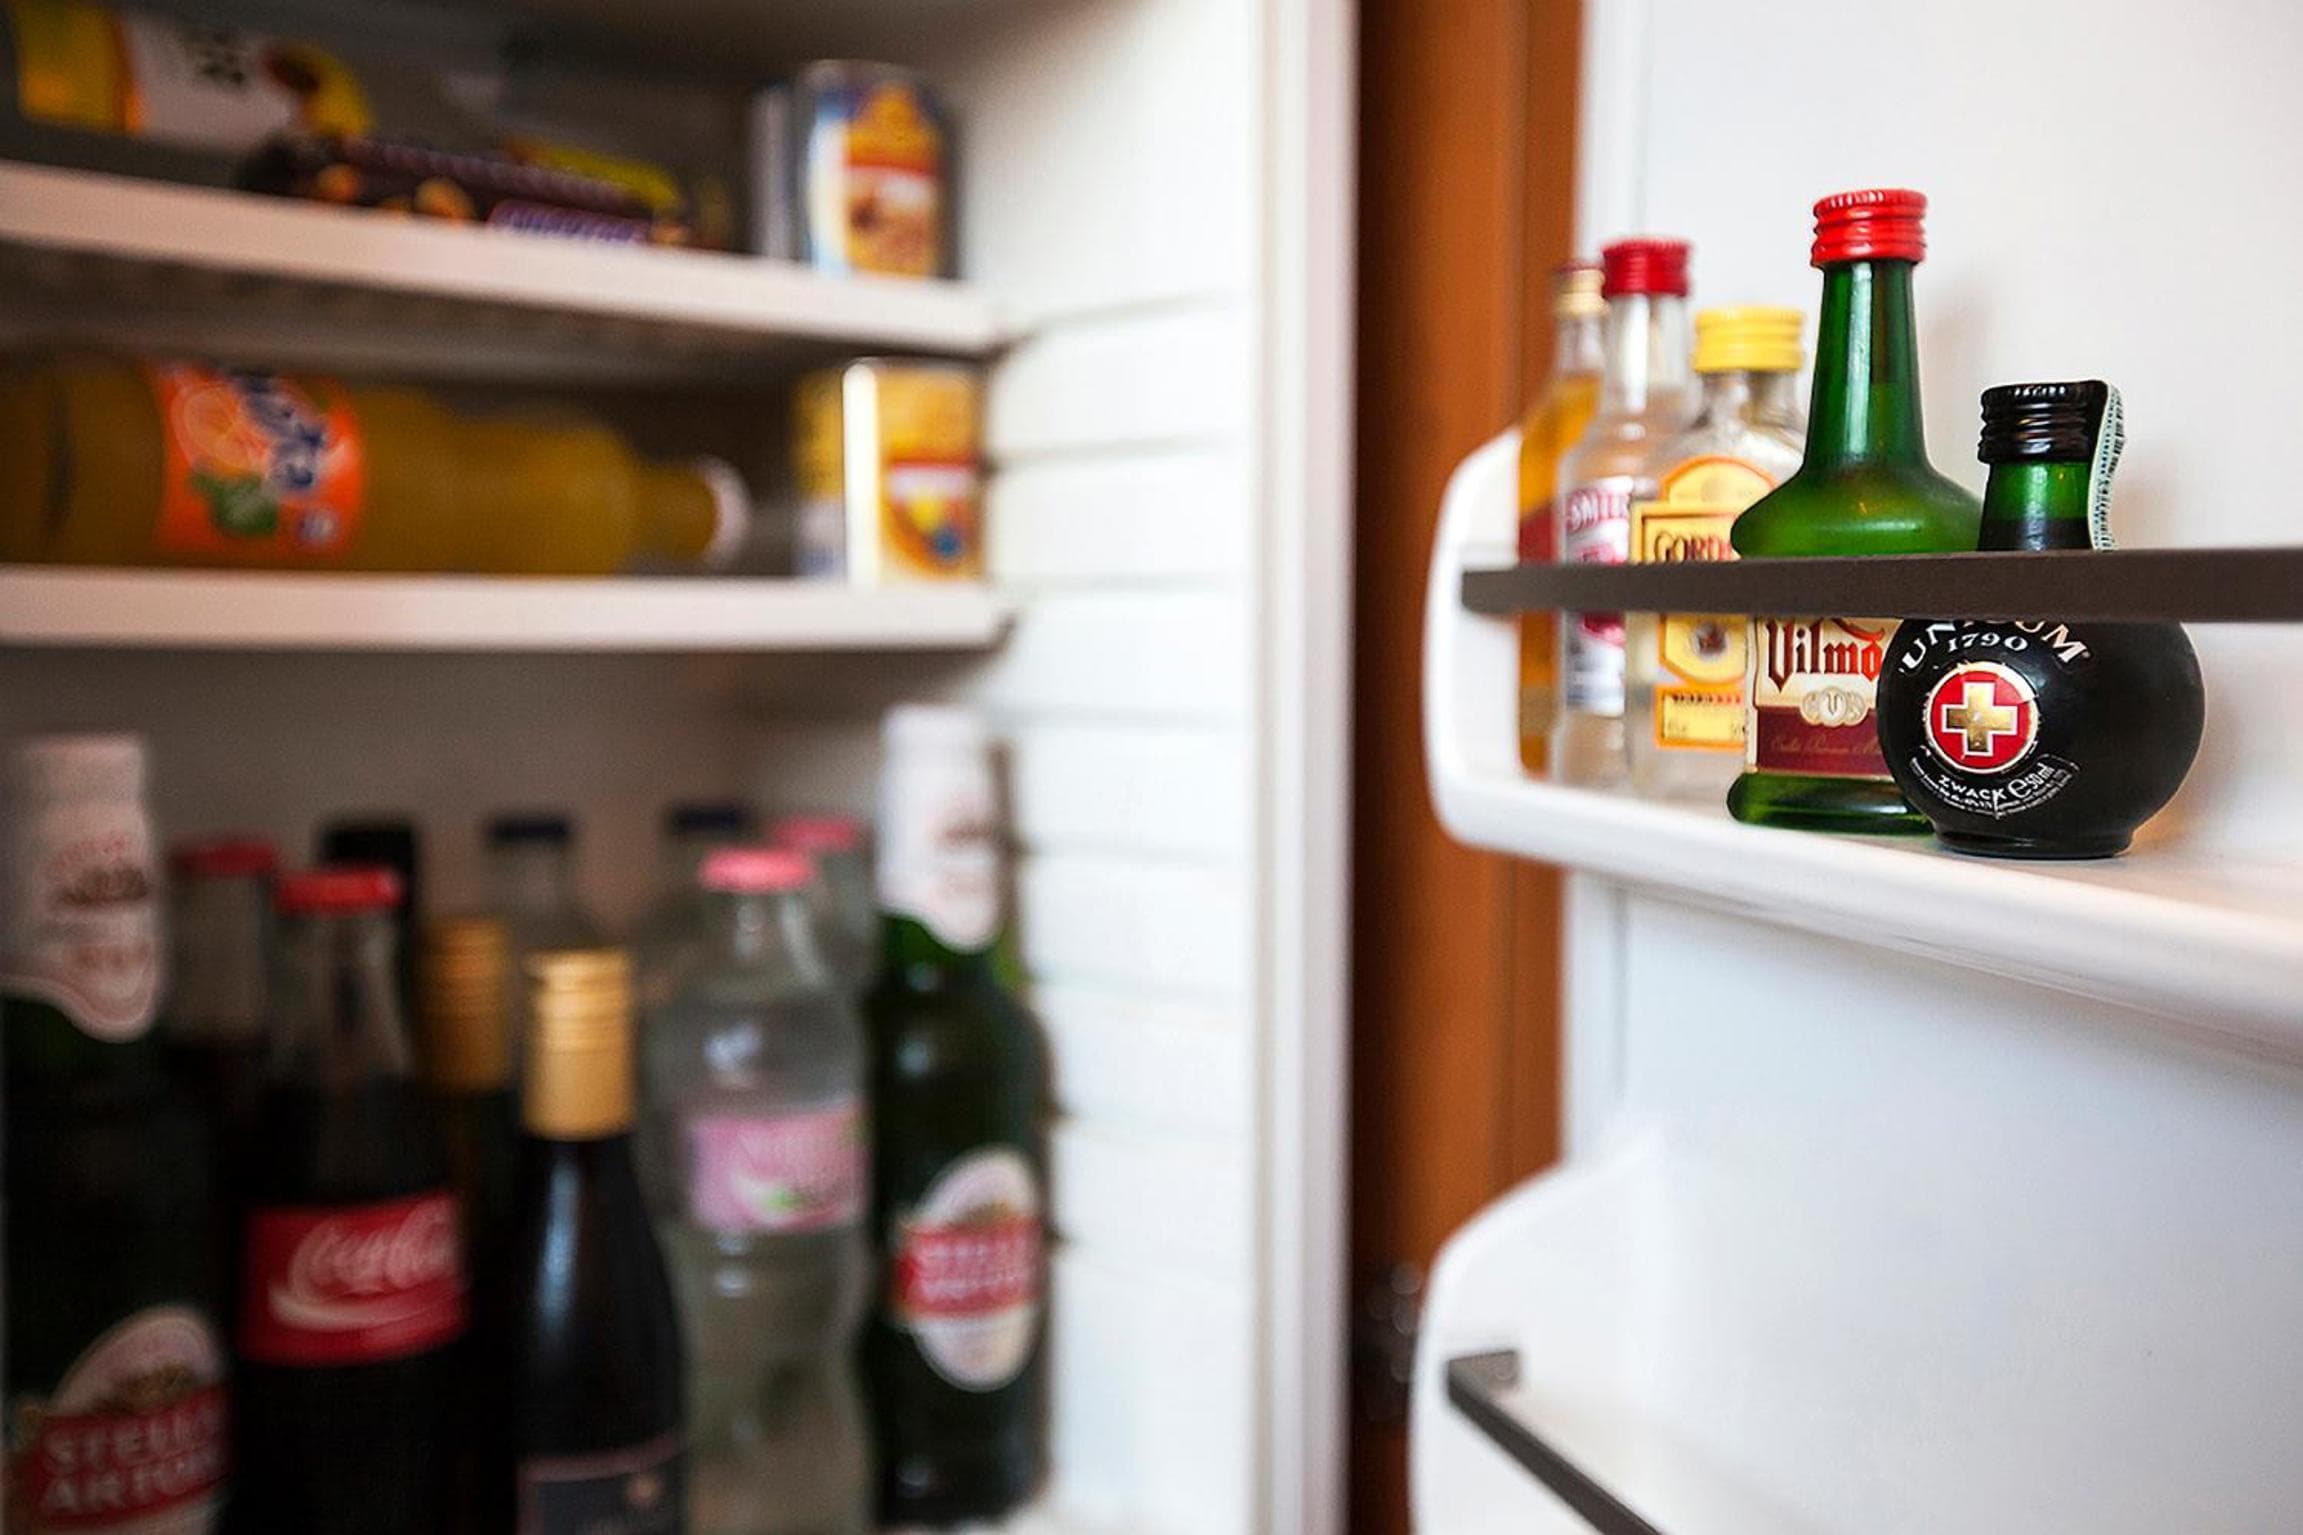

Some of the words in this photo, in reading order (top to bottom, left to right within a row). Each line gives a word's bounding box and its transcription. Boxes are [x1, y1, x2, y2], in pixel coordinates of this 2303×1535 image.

[1949, 632, 2028, 652] 1790
[1766, 618, 1885, 693] Vilmo
[1939, 775, 2007, 801] ZWACK
